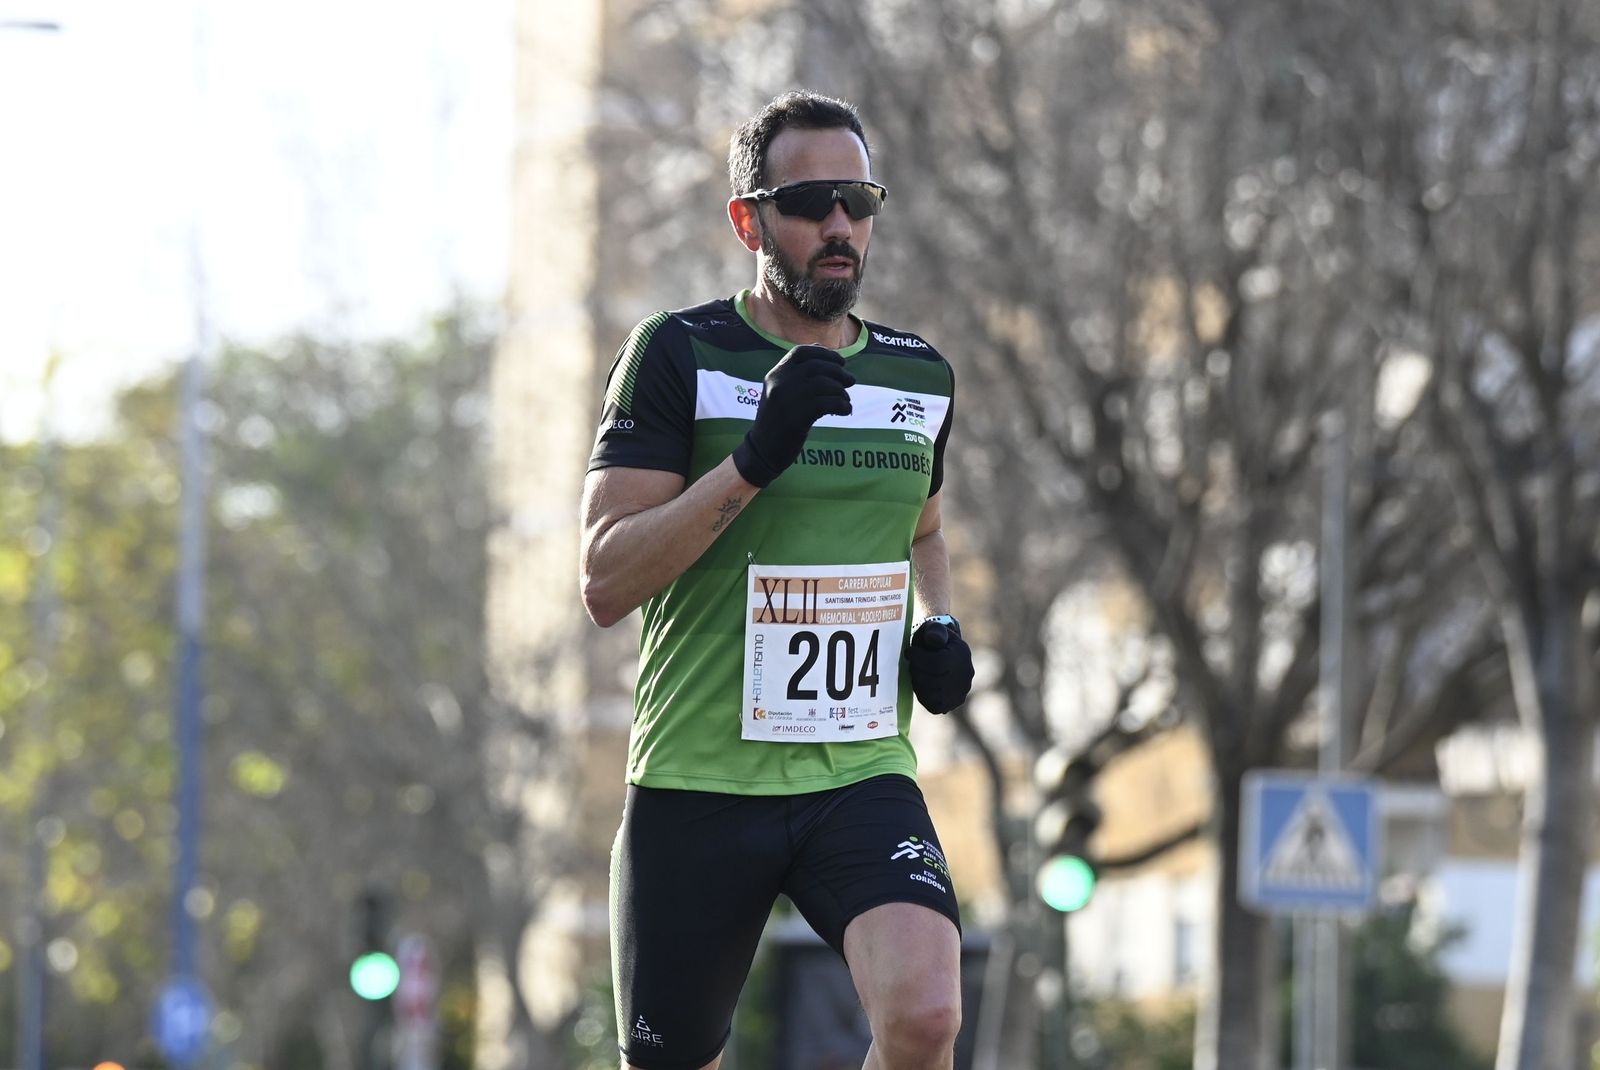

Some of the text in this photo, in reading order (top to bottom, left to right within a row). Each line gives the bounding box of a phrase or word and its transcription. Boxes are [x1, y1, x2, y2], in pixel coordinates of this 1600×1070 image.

[852, 450, 931, 476] CORDOBÉS
[838, 576, 892, 590] CARRERA POPULAR
[756, 578, 821, 624] XLII
[855, 595, 876, 603] TRINIDAD
[819, 612, 857, 624] MEMORIAL
[786, 629, 880, 701] 204
[782, 725, 816, 733] IMDECO
